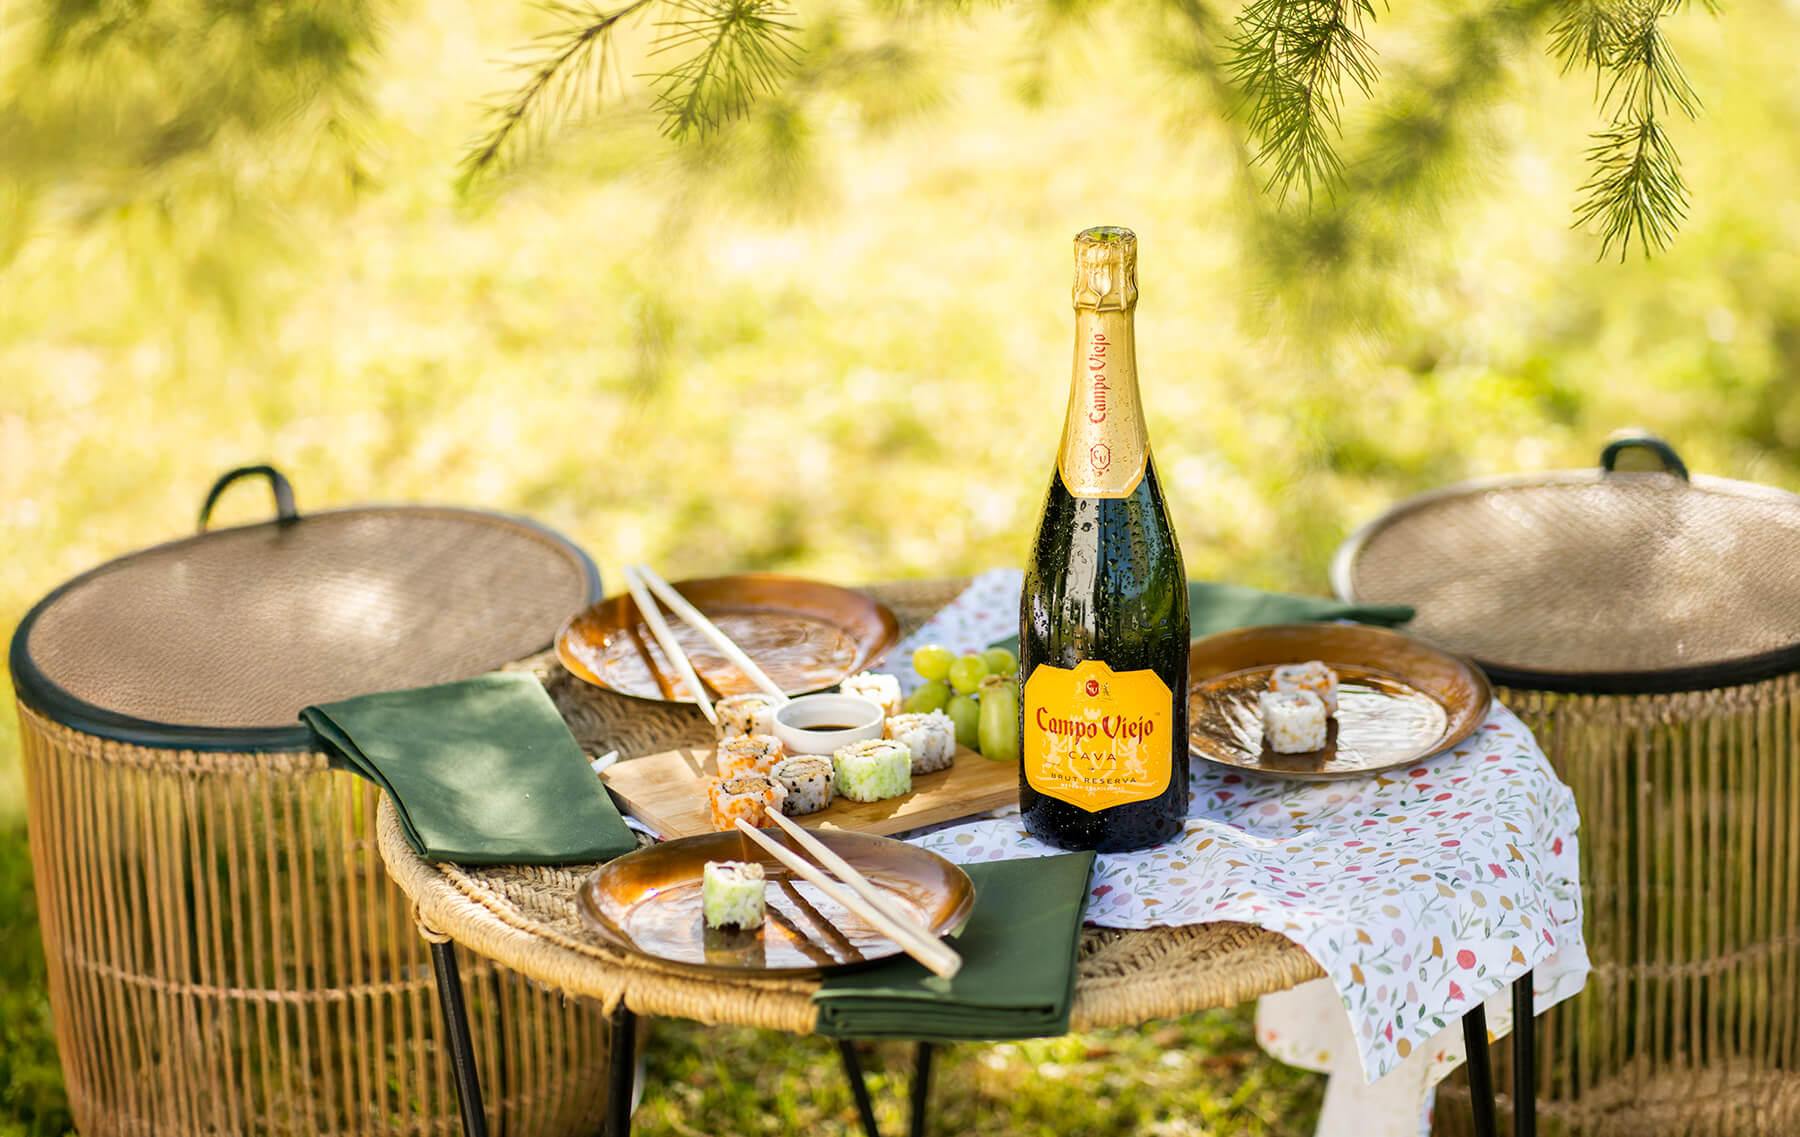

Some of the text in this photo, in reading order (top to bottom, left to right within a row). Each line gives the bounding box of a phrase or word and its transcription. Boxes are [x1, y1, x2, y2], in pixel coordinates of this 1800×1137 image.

[1089, 333, 1111, 424] Campo Viejo
[1036, 706, 1154, 745] Campo Viejo
[1068, 750, 1117, 761] CAVA
[1051, 772, 1137, 785] BRUT RESERVA
